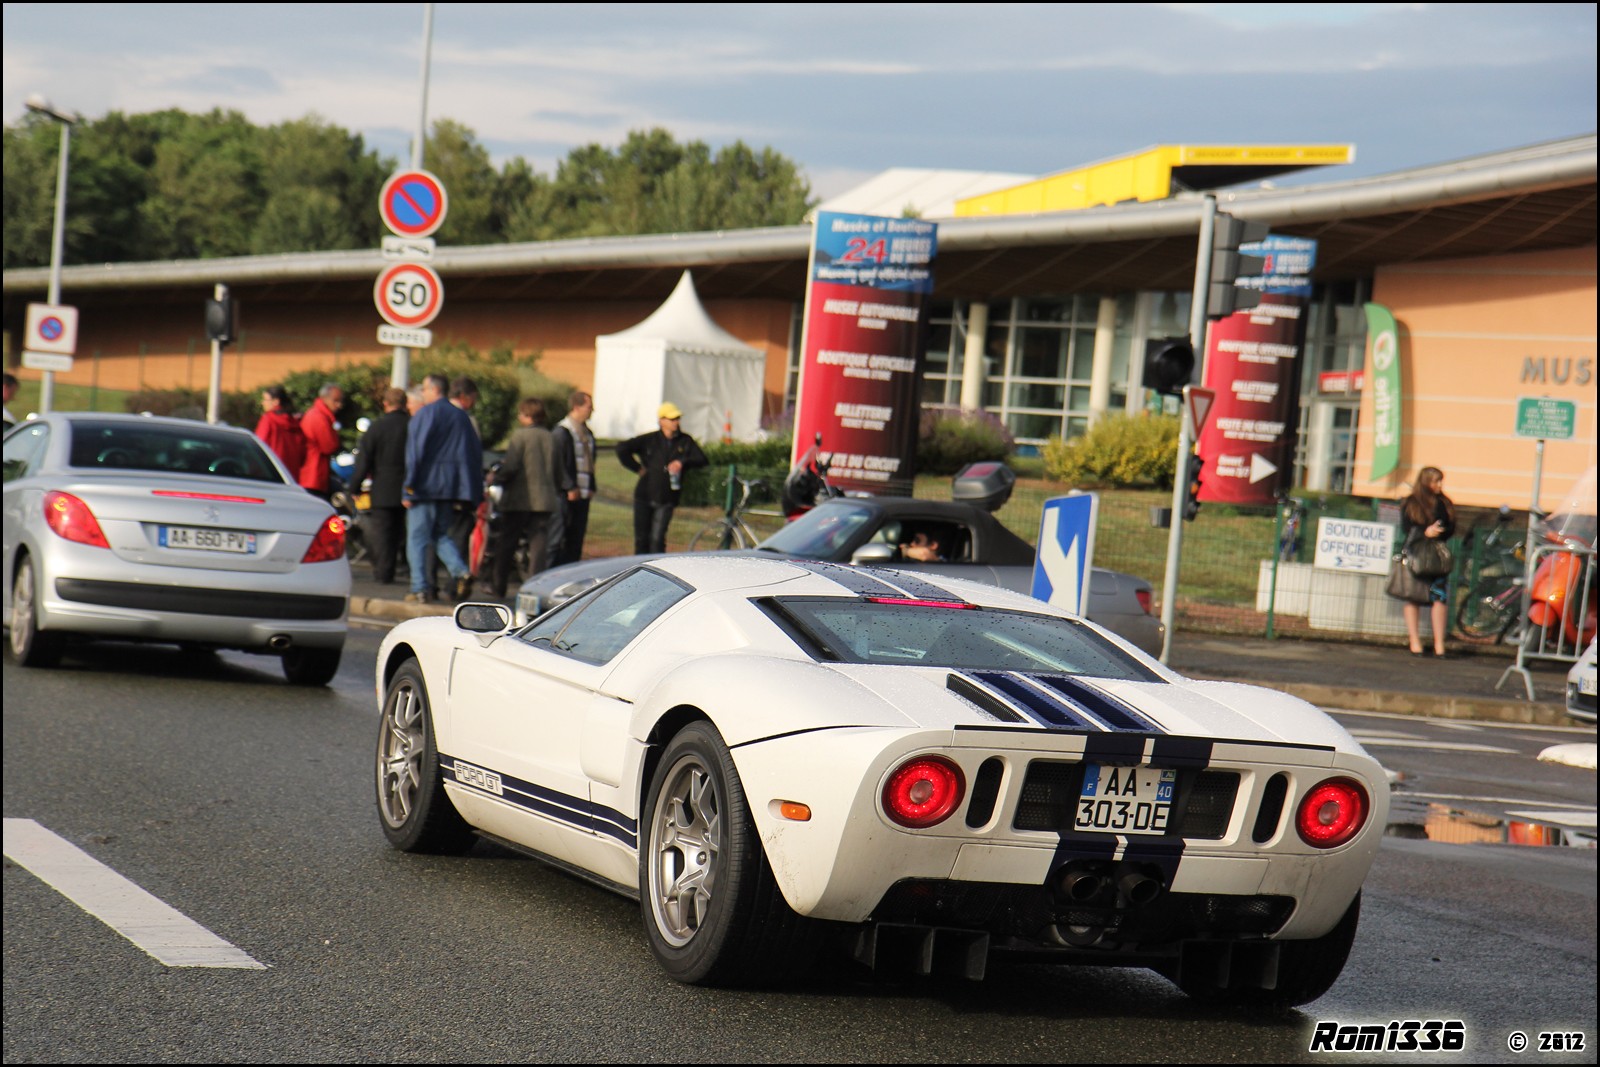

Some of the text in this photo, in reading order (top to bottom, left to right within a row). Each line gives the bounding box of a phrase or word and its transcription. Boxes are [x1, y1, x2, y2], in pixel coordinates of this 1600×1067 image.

[842, 236, 889, 264] 24
[392, 282, 427, 308] 50
[817, 350, 916, 373] BOUTIQUE OFFICIELLE
[1519, 356, 1597, 386] MUS
[864, 456, 900, 472] CIRCUIT
[1325, 522, 1386, 541] BOUTIQUE
[1320, 540, 1386, 559] OFFICIELLE
[456, 763, 485, 787] FORD
[1086, 783, 1094, 791] F
[1158, 786, 1172, 798] 40
